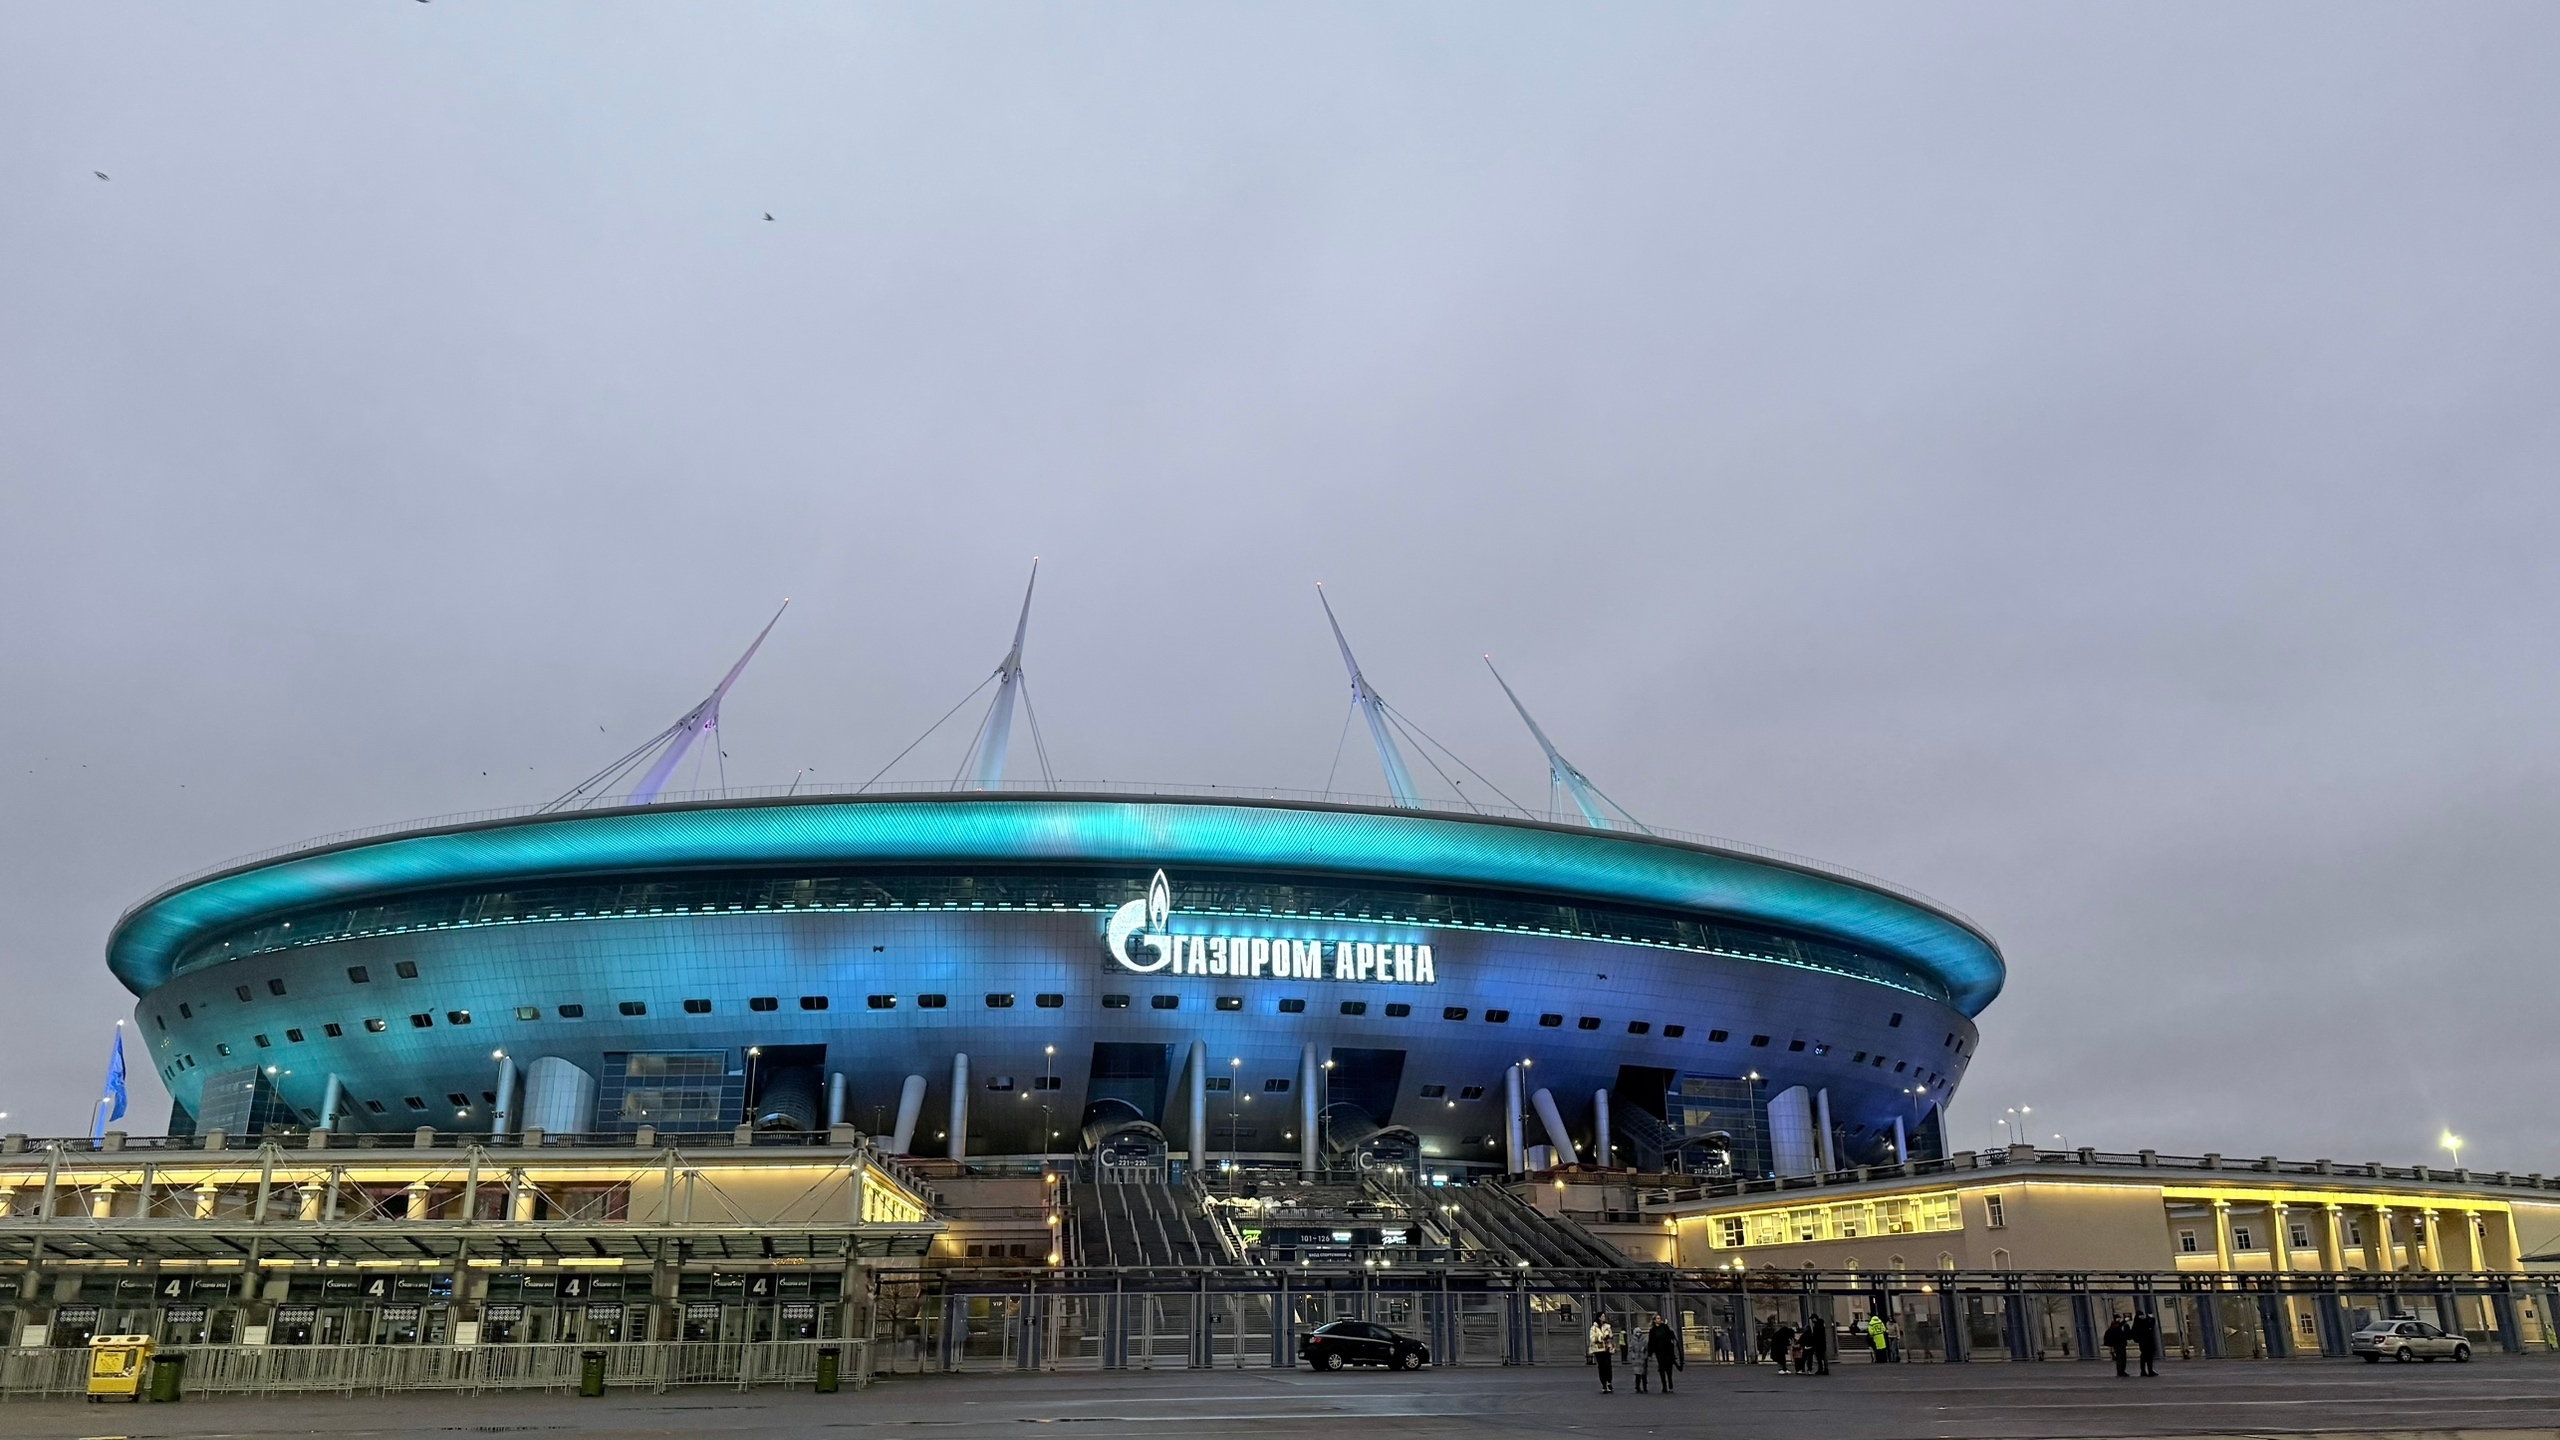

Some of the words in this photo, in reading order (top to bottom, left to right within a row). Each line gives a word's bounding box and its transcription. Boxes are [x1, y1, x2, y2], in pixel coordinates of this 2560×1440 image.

[1172, 935, 1323, 979] ГАЗПРОМ
[1335, 941, 1436, 984] АРЕНА
[164, 1279, 181, 1297] 4
[368, 1279, 385, 1297] 4
[564, 1278, 580, 1297] 4
[752, 1277, 768, 1296] 4
